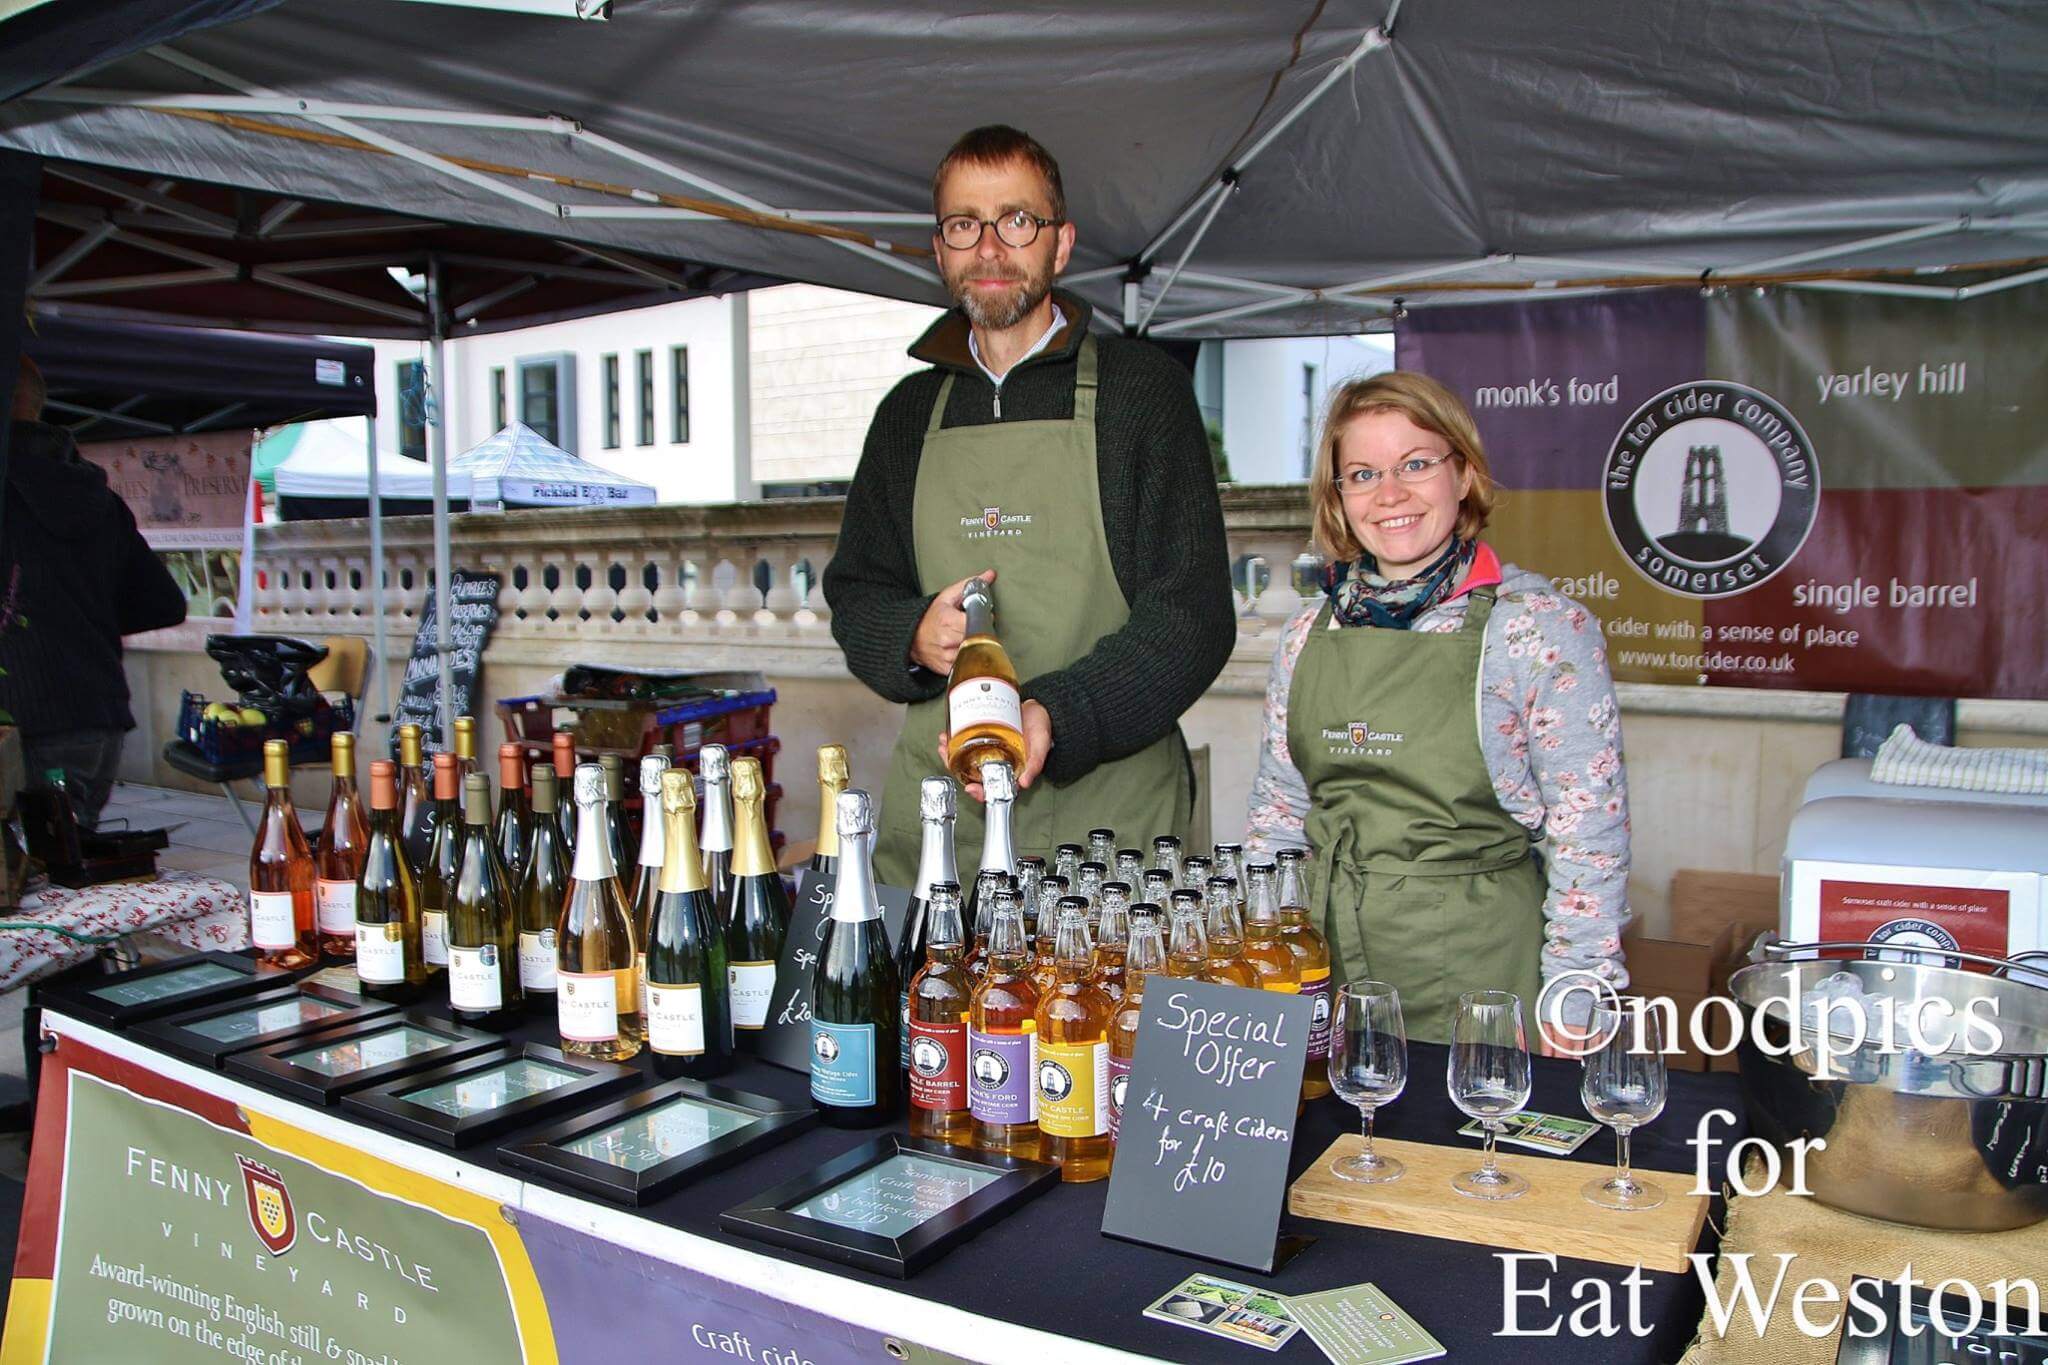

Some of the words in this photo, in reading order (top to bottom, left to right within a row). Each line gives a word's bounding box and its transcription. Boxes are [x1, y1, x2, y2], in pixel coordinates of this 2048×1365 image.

[1475, 377, 1562, 408] monk's
[1567, 374, 1619, 407] ford
[1815, 364, 1910, 404] yarley
[1917, 360, 1967, 395] hill
[1609, 450, 1636, 490] the
[1627, 413, 1659, 447] tor
[1663, 387, 1725, 420] cider
[1732, 398, 1810, 491] company
[606, 486, 629, 499] Bar
[1000, 514, 1033, 524] CASTLE
[1636, 545, 1771, 591] somerset
[1791, 578, 1881, 616] single
[1888, 576, 1979, 608] barrel
[1606, 616, 1651, 638] cider
[1653, 618, 1696, 641] with
[1702, 624, 1712, 641] a
[1718, 622, 1775, 642] sense
[1779, 622, 1800, 644] of
[1804, 622, 1860, 649] place
[1617, 649, 1797, 674] www.torcider.co.uk
[1367, 731, 1405, 743] CASTLE
[1894, 920, 1922, 932] cider
[732, 988, 770, 997] CASTLE
[1157, 993, 1288, 1057] Special
[925, 1080, 961, 1089] BARREL
[1195, 1041, 1277, 1088] Offer
[992, 1093, 1018, 1102] FORD
[1049, 1104, 1086, 1115] CASTLE
[1142, 1087, 1169, 1121] 4
[1178, 1109, 1230, 1142] craft
[1234, 1115, 1289, 1143] Ciders
[1155, 1125, 1183, 1167] for
[1174, 1133, 1226, 1192] £10
[126, 1145, 232, 1207] FENNY
[306, 1210, 440, 1293] CASTLE
[161, 1221, 409, 1325] VINEYARD
[89, 1253, 221, 1323] Award-winning
[223, 1293, 285, 1335] English
[289, 1324, 321, 1354] still
[325, 1336, 342, 1360] &
[107, 1297, 164, 1328] grown
[167, 1314, 191, 1338] on
[195, 1319, 224, 1350] the
[227, 1333, 266, 1365] edge
[691, 1323, 756, 1362] Craft
